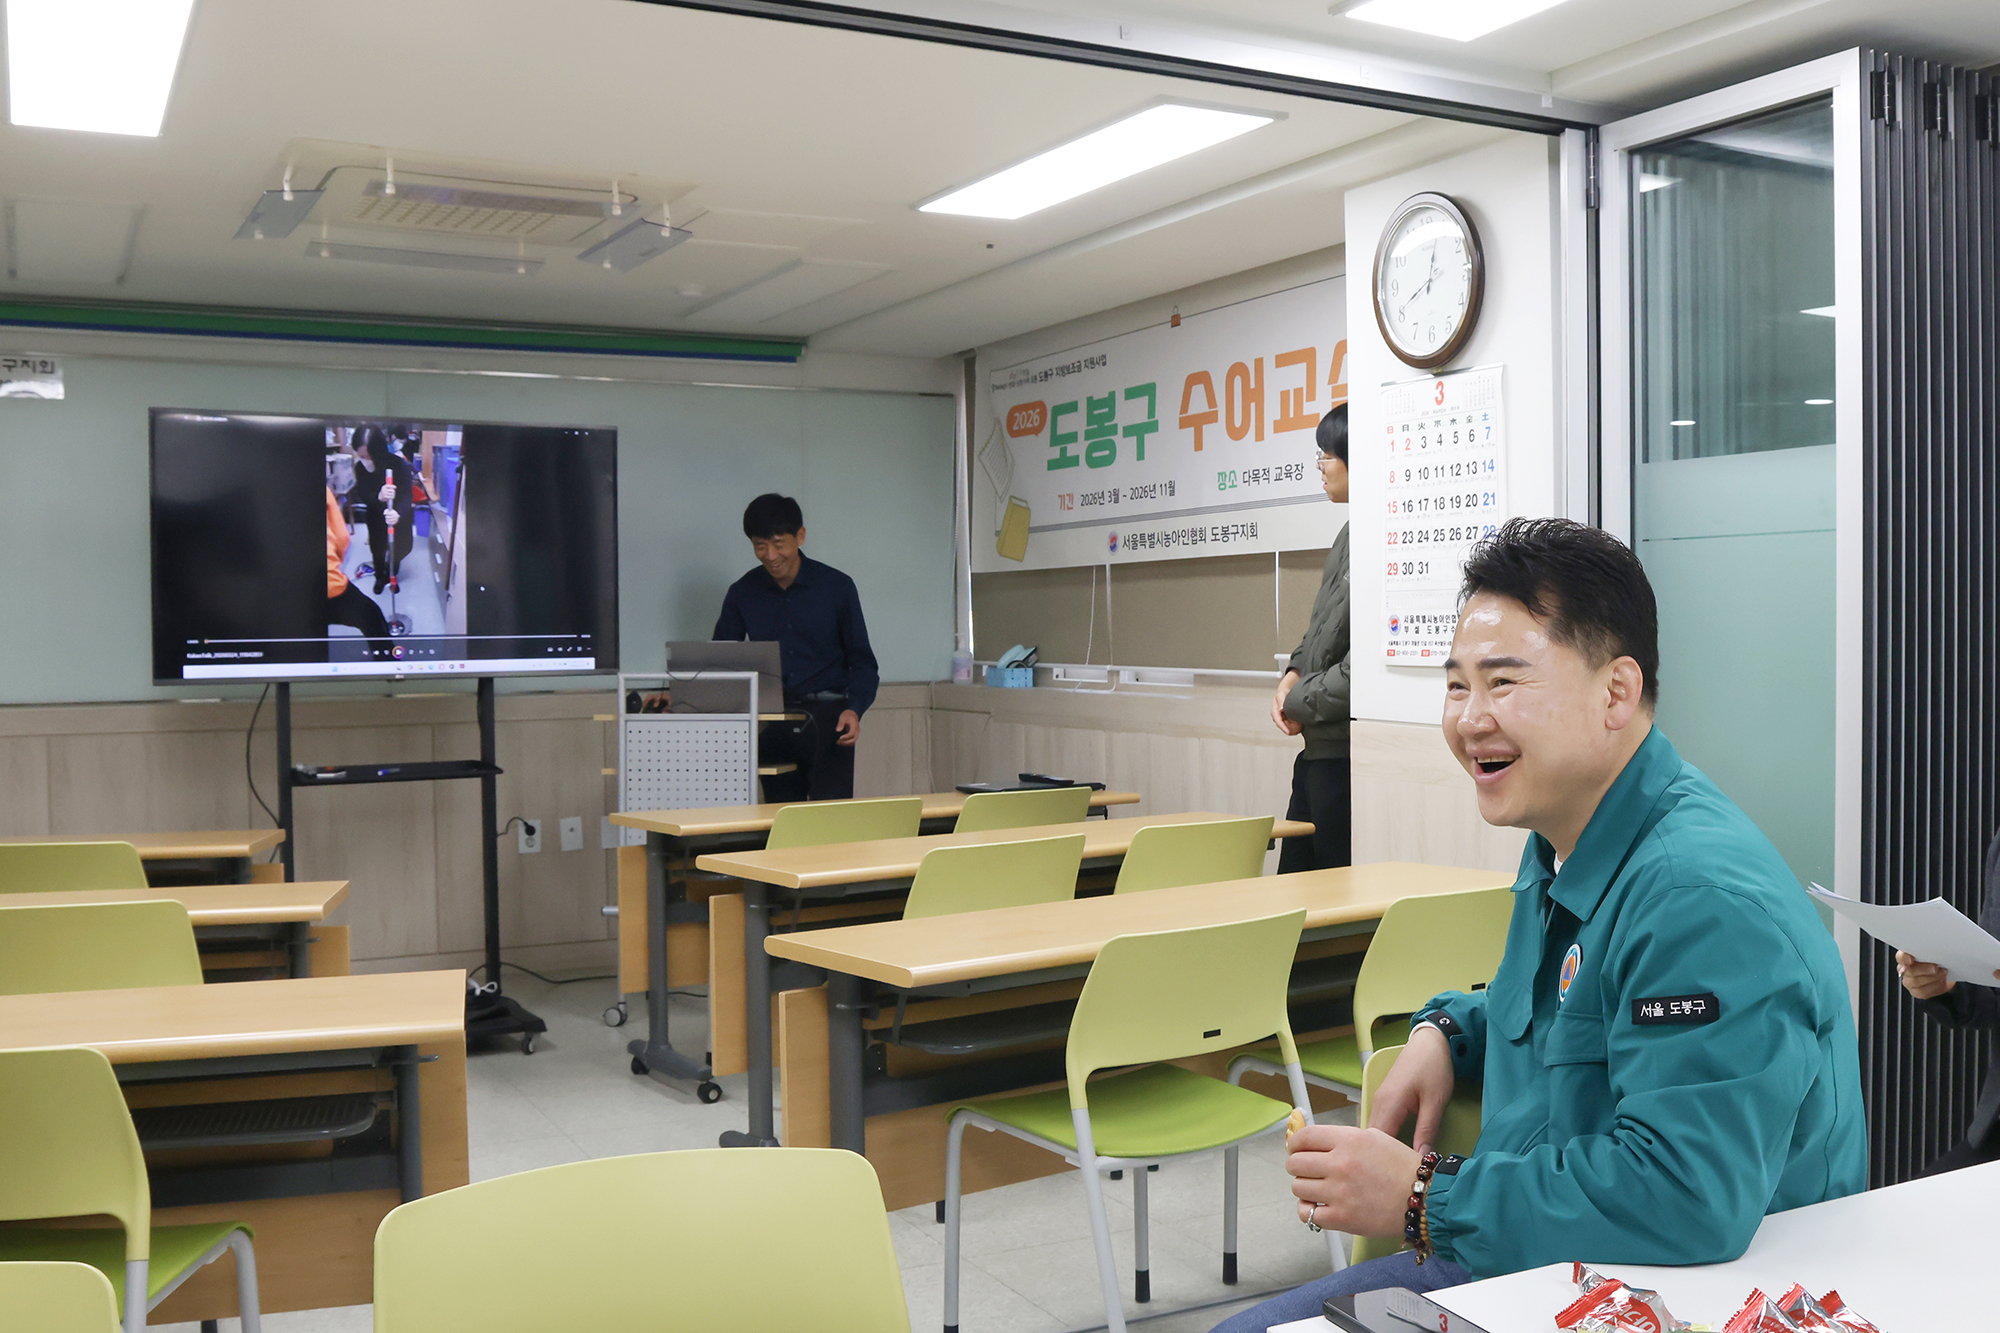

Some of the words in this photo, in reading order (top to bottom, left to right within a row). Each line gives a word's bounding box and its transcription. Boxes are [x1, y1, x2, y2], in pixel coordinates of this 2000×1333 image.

[1392, 279, 1399, 297] 9
[1458, 292, 1464, 306] 4
[1398, 305, 1406, 323] 8
[1445, 316, 1452, 334] 5
[1413, 322, 1418, 340] 7
[1428, 325, 1436, 343] 6
[1038, 368, 1054, 382] 도봉구
[1055, 360, 1082, 377] 지방보조금
[1084, 354, 1107, 370] 지원사업
[1435, 381, 1444, 405] 3
[1012, 408, 1040, 430] 2026
[1047, 382, 1159, 471] 도봉구
[1390, 440, 1394, 452] 1
[1405, 438, 1411, 451] 2
[1421, 436, 1427, 449] 3
[1437, 434, 1443, 446] 4
[1453, 431, 1459, 444] 5
[1469, 429, 1475, 442] 6
[1485, 426, 1491, 440] 7
[1218, 470, 1238, 491] 장소
[1242, 467, 1270, 486] 다목적
[1274, 463, 1304, 481] 교육장
[1390, 470, 1395, 483] 8
[1405, 469, 1411, 482] 9
[1418, 467, 1429, 480] 10
[1434, 465, 1444, 478] 11
[1450, 463, 1461, 476] 12
[1466, 461, 1478, 475] 13
[1482, 459, 1494, 473] 14
[1058, 493, 1074, 510] 기간
[1080, 490, 1105, 506] 2026년
[1108, 488, 1119, 504] 3월
[1130, 483, 1156, 500] 2026년
[1160, 480, 1175, 496] 11월
[1388, 501, 1398, 514] 15
[1402, 500, 1413, 513] 16
[1418, 498, 1429, 511] 17
[1434, 497, 1445, 510] 18
[1450, 495, 1461, 508] 19
[1466, 494, 1478, 507] 20
[1483, 492, 1495, 506] 21
[1122, 527, 1206, 550] 서울특별시농아인협회
[1211, 522, 1258, 543] 도봉구지회
[1388, 532, 1398, 544] 22
[1402, 531, 1413, 544] 23
[1418, 530, 1429, 542] 24
[1434, 529, 1445, 542] 25
[1449, 528, 1461, 541] 26
[1466, 526, 1478, 540] 27
[1483, 525, 1496, 539] 28
[1388, 563, 1398, 575] 29
[1402, 562, 1414, 575] 30
[1418, 561, 1429, 574] 31
[1641, 1002, 1664, 1017] 서울
[1670, 1000, 1706, 1014] 도봉구
